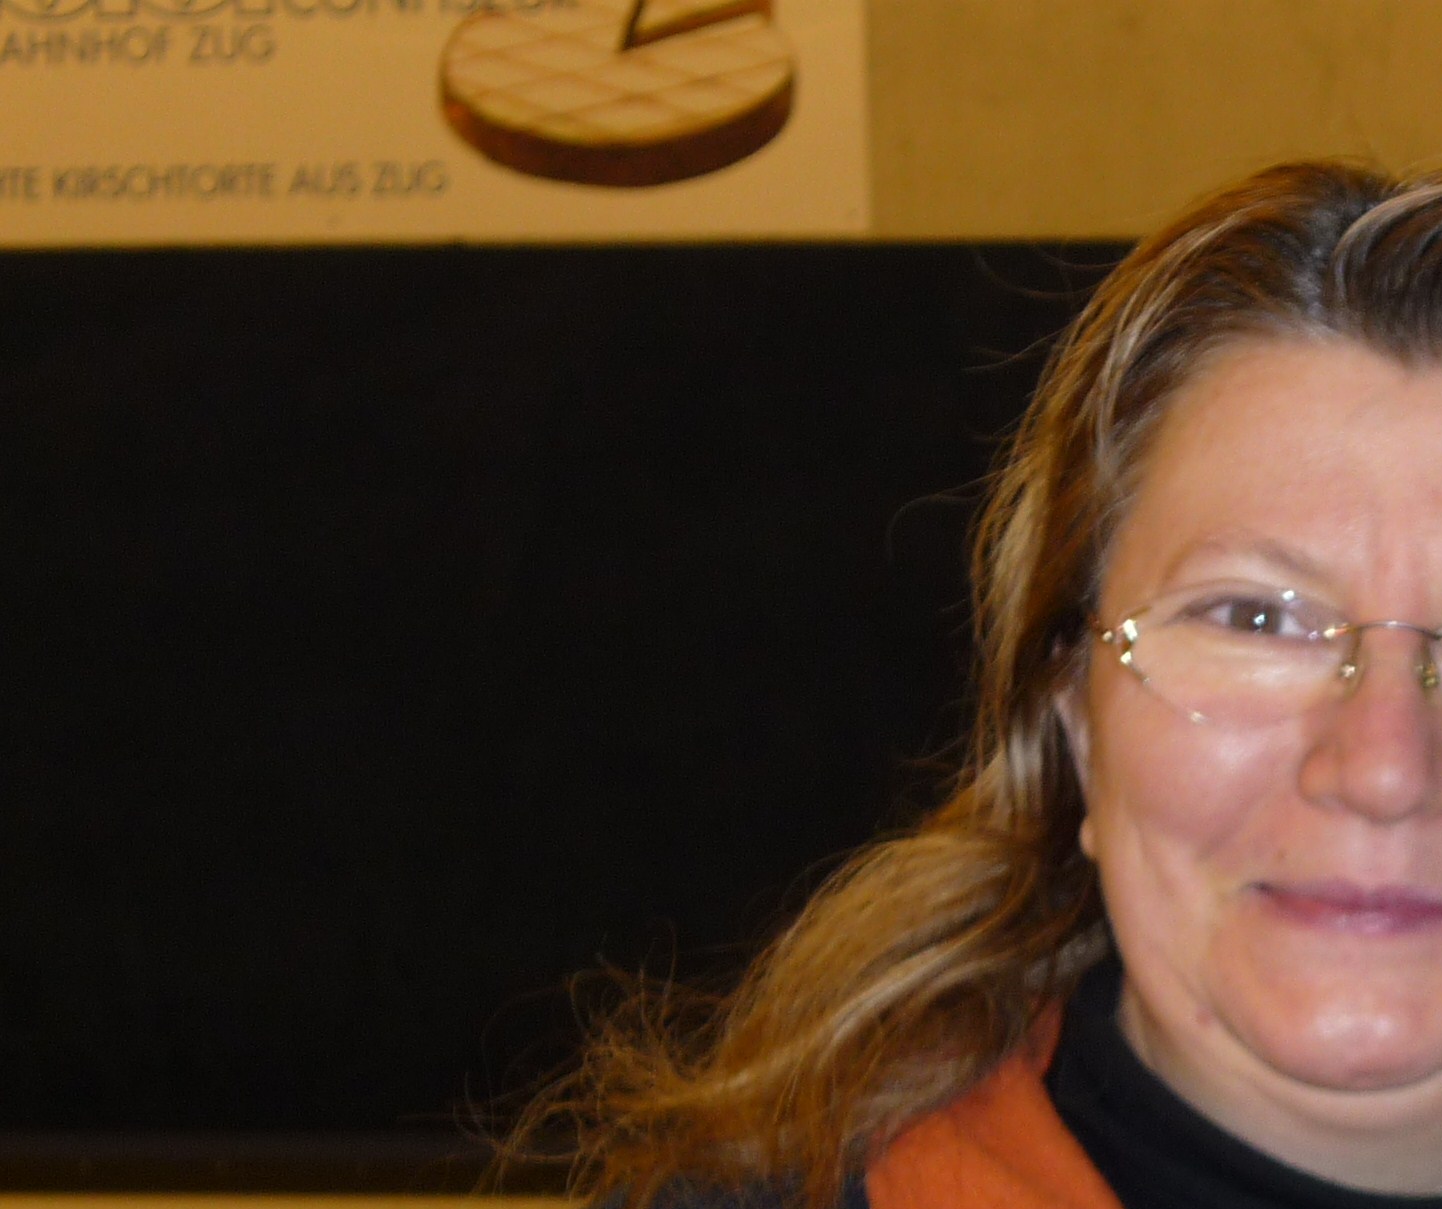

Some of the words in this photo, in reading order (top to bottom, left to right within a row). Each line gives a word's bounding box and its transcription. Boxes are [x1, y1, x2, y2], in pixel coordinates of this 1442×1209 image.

[189, 23, 276, 63] ZUG
[53, 163, 275, 201] KIRSCHTORTE
[288, 162, 360, 200] AUS
[370, 160, 448, 199] ZUG
